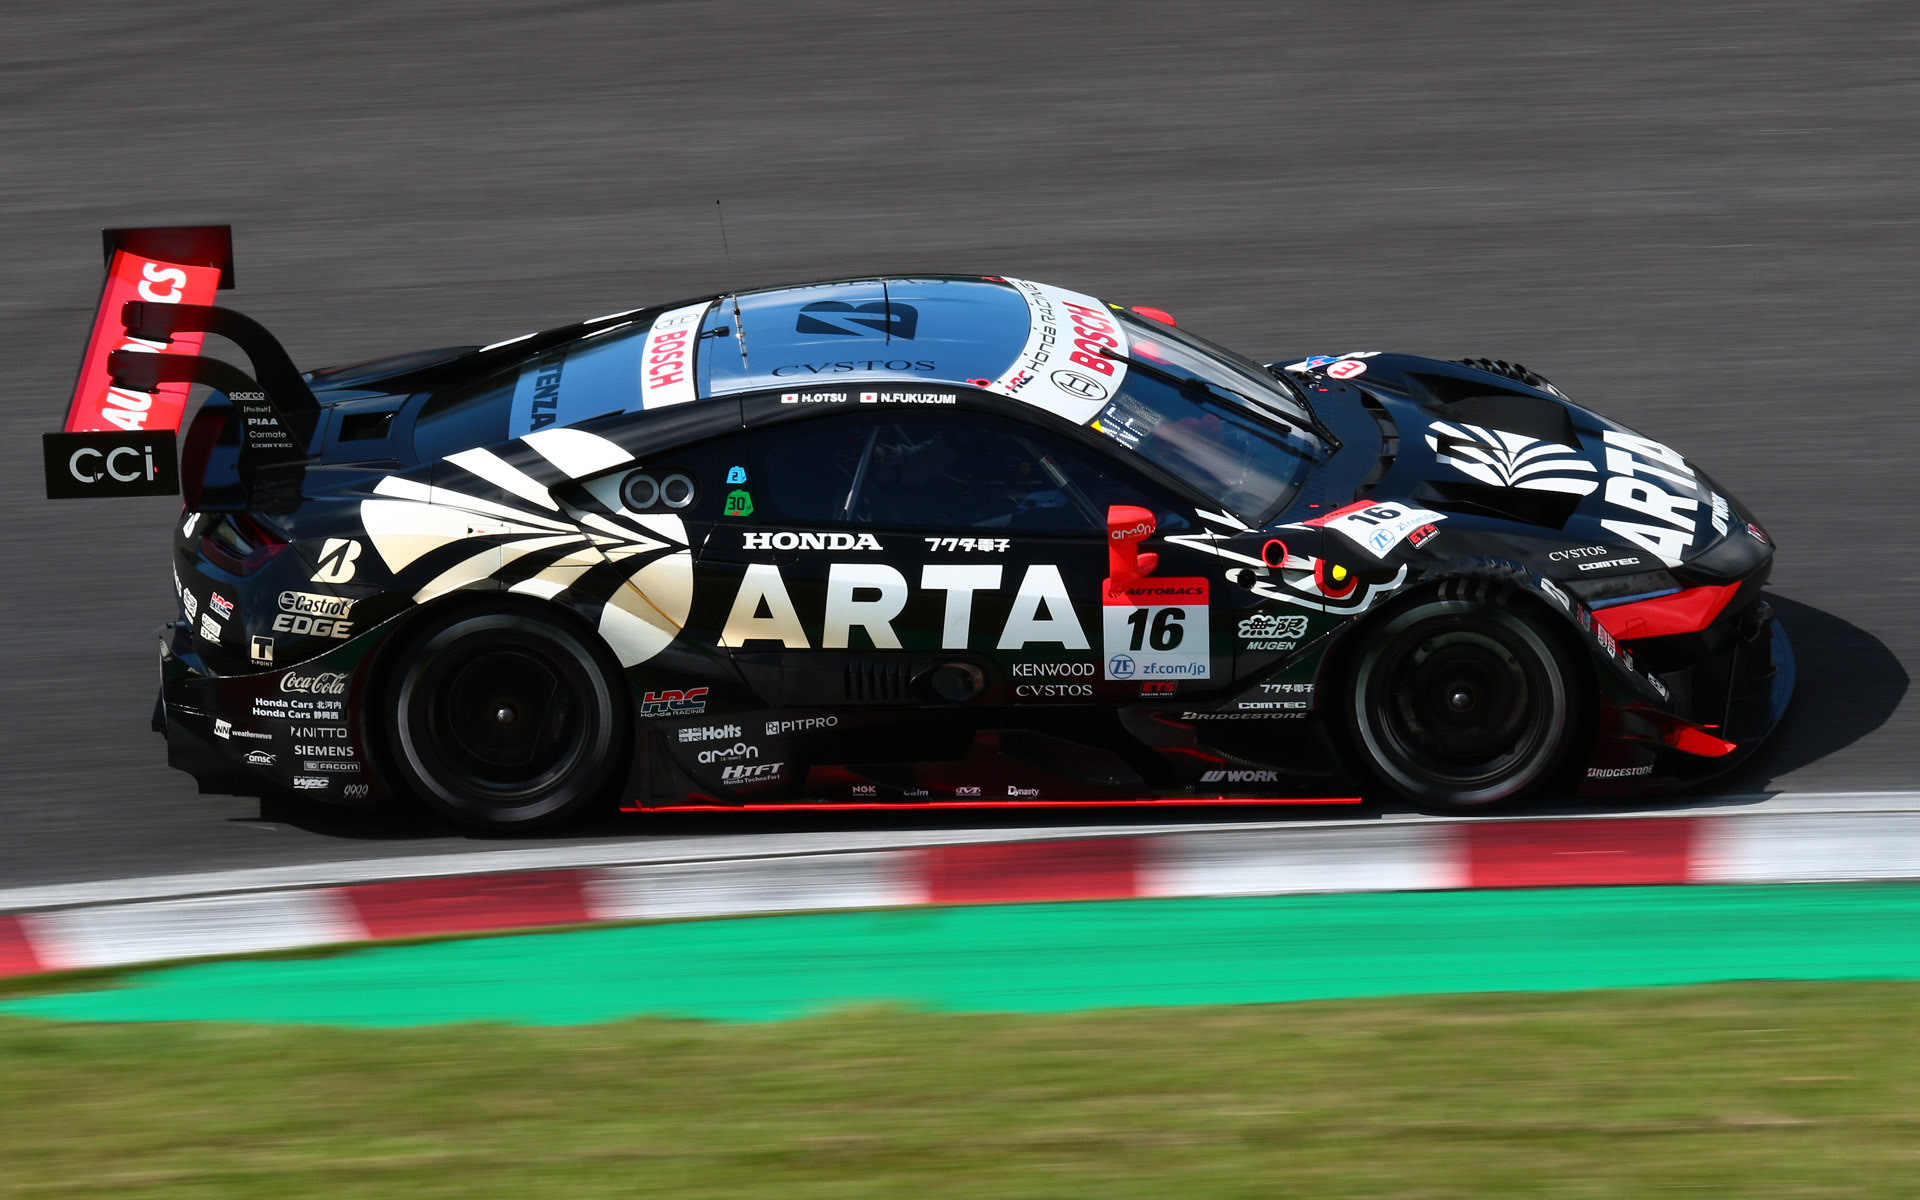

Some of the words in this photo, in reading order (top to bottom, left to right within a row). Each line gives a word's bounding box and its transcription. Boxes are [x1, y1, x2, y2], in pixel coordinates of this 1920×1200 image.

[1061, 301, 1119, 377] BOSCH
[101, 262, 187, 432] AUCS
[1025, 325, 1057, 373] Honda
[648, 329, 688, 390] BOSCH
[771, 360, 936, 377] CVSTOS
[801, 393, 847, 404] H.OTSU
[880, 392, 956, 405] N.FUKUZUMI
[248, 418, 279, 426] PIAA
[249, 431, 287, 439] Carmate
[732, 471, 739, 482] 2
[727, 496, 746, 511] 30
[1600, 429, 1698, 569] ARTA
[1347, 507, 1402, 526] 16
[1408, 523, 1436, 545] ETS
[743, 532, 884, 551] HONDA
[1548, 546, 1608, 562] CVSTOS
[1577, 557, 1641, 571] COMTEC
[1127, 587, 1204, 596] AUTOBACS
[294, 596, 347, 616] Castrol
[716, 563, 1092, 651] ARTA
[272, 613, 355, 639] EDGE
[1126, 607, 1187, 652] 16
[1246, 642, 1296, 651] MUGEN
[251, 659, 273, 667] T-POINT
[1012, 663, 1095, 677] KENWOOD
[1143, 662, 1206, 676] zf.com/jp
[280, 671, 349, 694] Coca-Cola
[1141, 681, 1177, 693] ETS
[1016, 684, 1093, 696] CVSTOS
[255, 698, 289, 708] Honda
[290, 700, 314, 709] Cars
[640, 687, 709, 713] HRC
[1238, 701, 1307, 710] COMTEC
[252, 707, 286, 718] Honda
[288, 709, 311, 719] Cars
[672, 708, 705, 716] RACING
[1180, 711, 1307, 720] BRIDGESTONE
[781, 716, 839, 732] PITPRO
[232, 730, 273, 740] weathernews
[303, 727, 347, 738] NITTO
[702, 724, 742, 741] Holts
[294, 745, 355, 757] SIEMENS
[697, 742, 759, 764] amon
[1227, 771, 1279, 782] WORK
[1587, 765, 1654, 778] BRIDGESTONE
[1007, 785, 1040, 797] Dynasty
